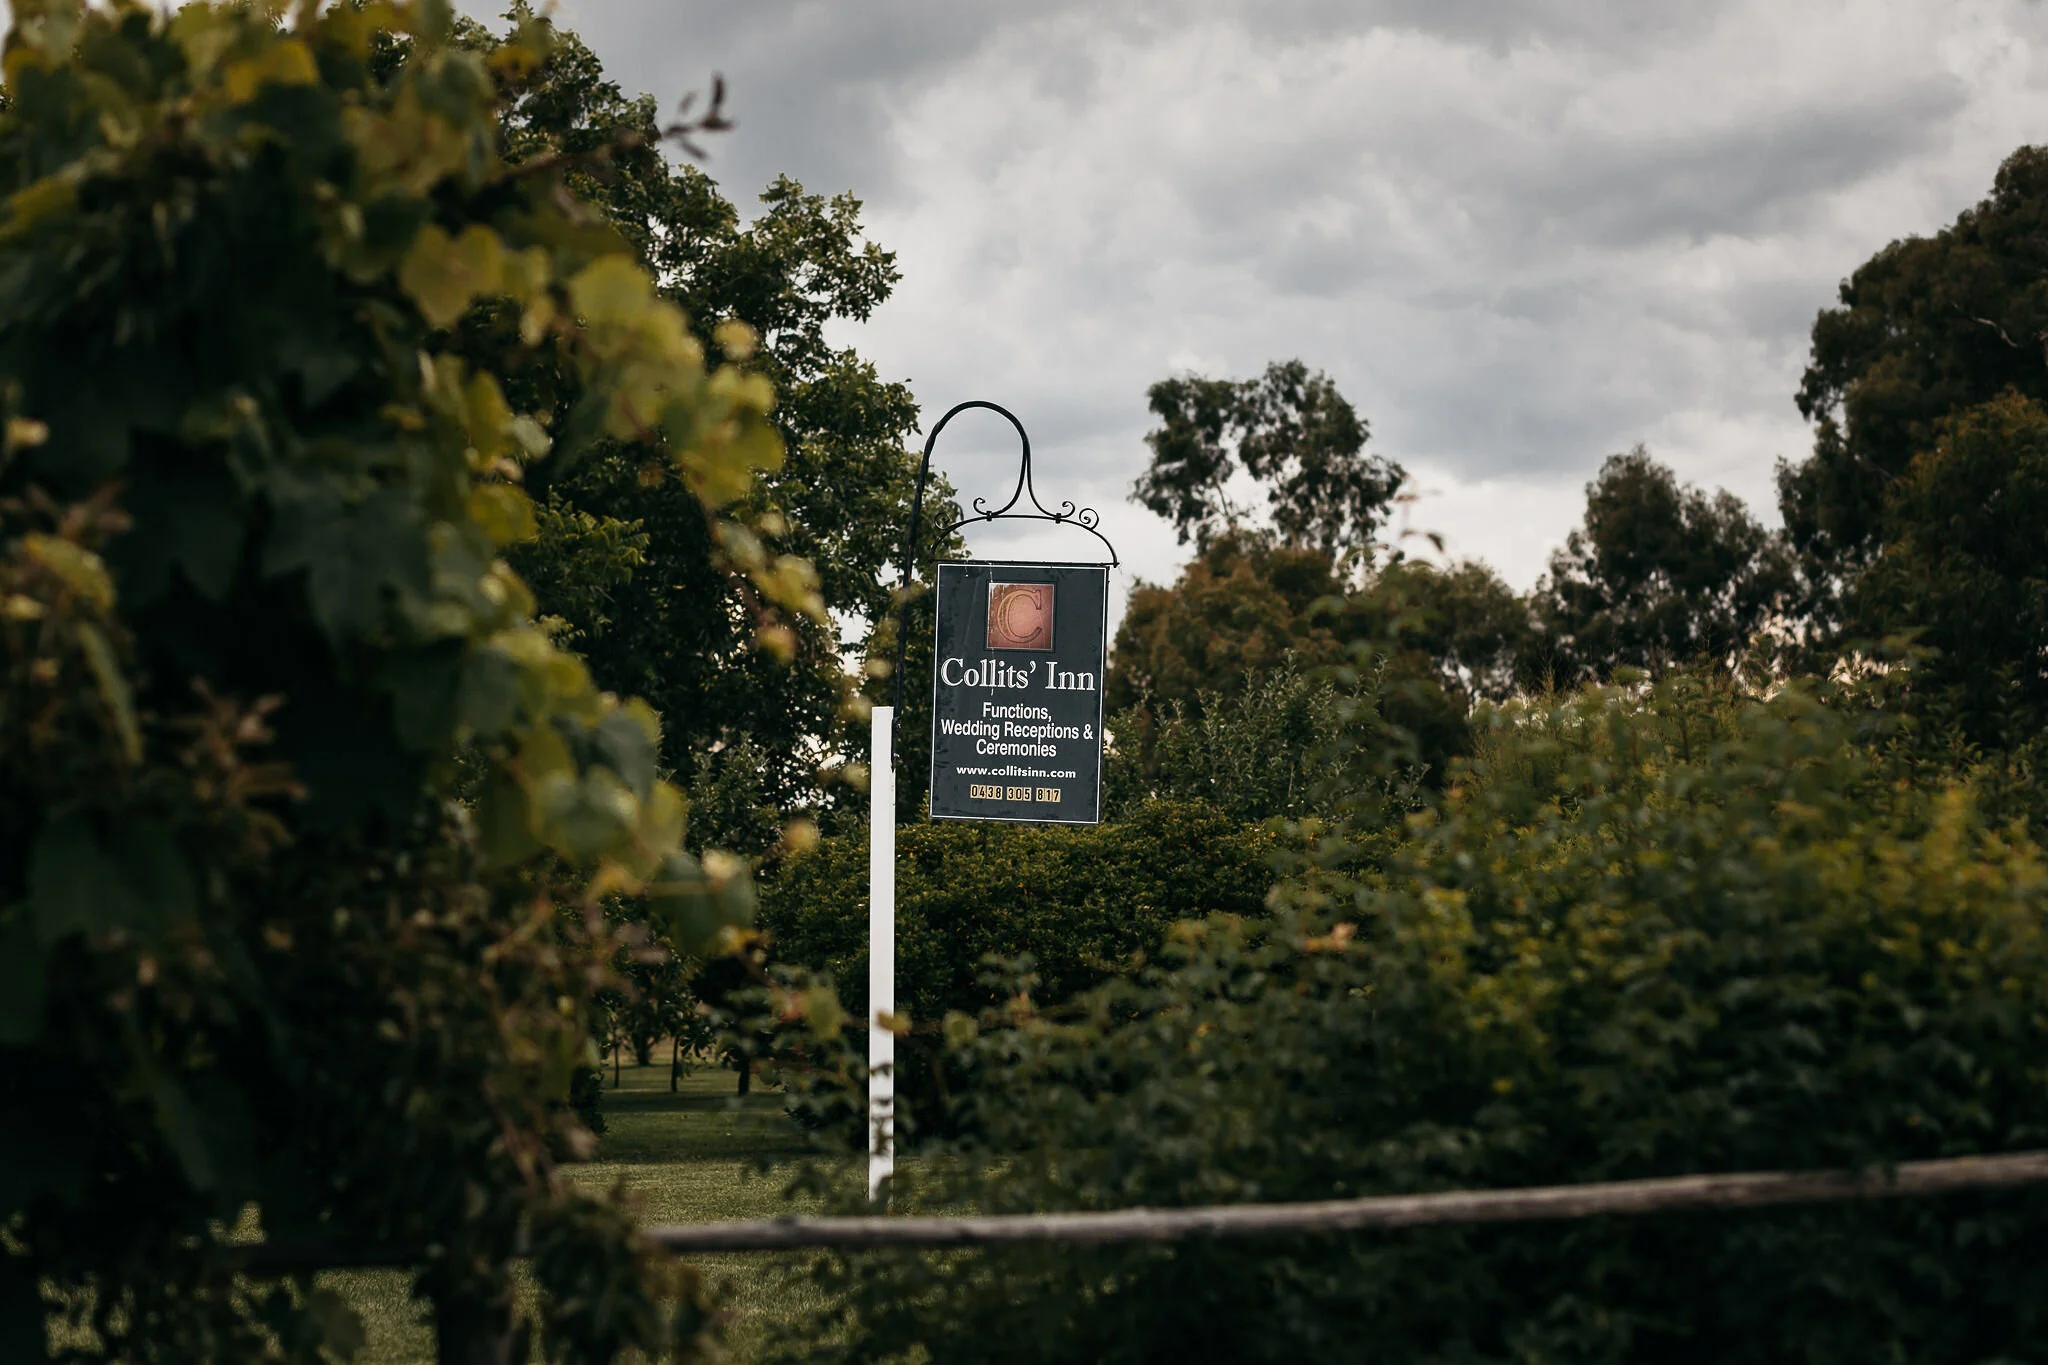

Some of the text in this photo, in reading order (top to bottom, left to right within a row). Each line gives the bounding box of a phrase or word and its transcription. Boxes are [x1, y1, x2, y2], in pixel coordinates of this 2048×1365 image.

[997, 589, 1042, 644] C
[1045, 661, 1095, 691] Inn
[982, 702, 1052, 722] Functions,
[941, 719, 1094, 744] Wedding Receptions &
[976, 738, 1057, 757] Ceremonies
[956, 765, 1077, 779] www.collitsinn.com
[971, 785, 1060, 802] 0438 305 817
